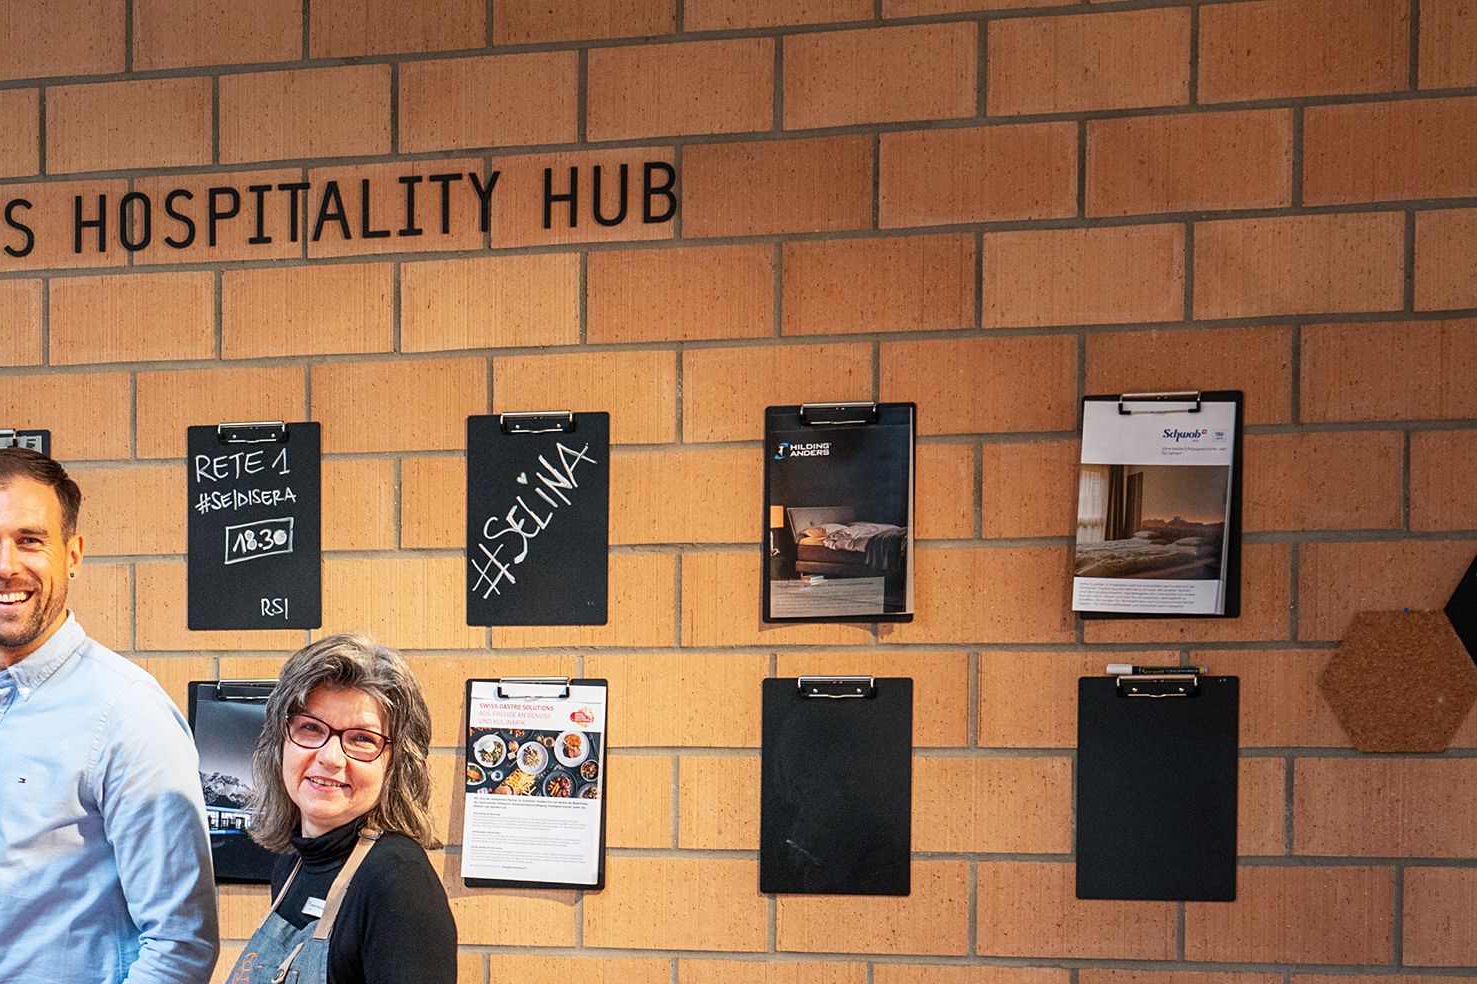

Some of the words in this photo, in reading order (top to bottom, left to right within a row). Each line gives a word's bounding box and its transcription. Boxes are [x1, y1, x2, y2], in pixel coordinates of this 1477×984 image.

[74, 170, 501, 255] HOSPITALITY
[543, 161, 678, 229] HUB
[790, 442, 830, 451] HILDING
[1162, 428, 1201, 442] Schwob
[195, 450, 265, 483] RETE
[271, 447, 291, 475] 1
[789, 449, 830, 457] ANDERS
[471, 441, 598, 600] #SELINA
[232, 528, 288, 554] 18.30
[260, 598, 289, 620] RSI
